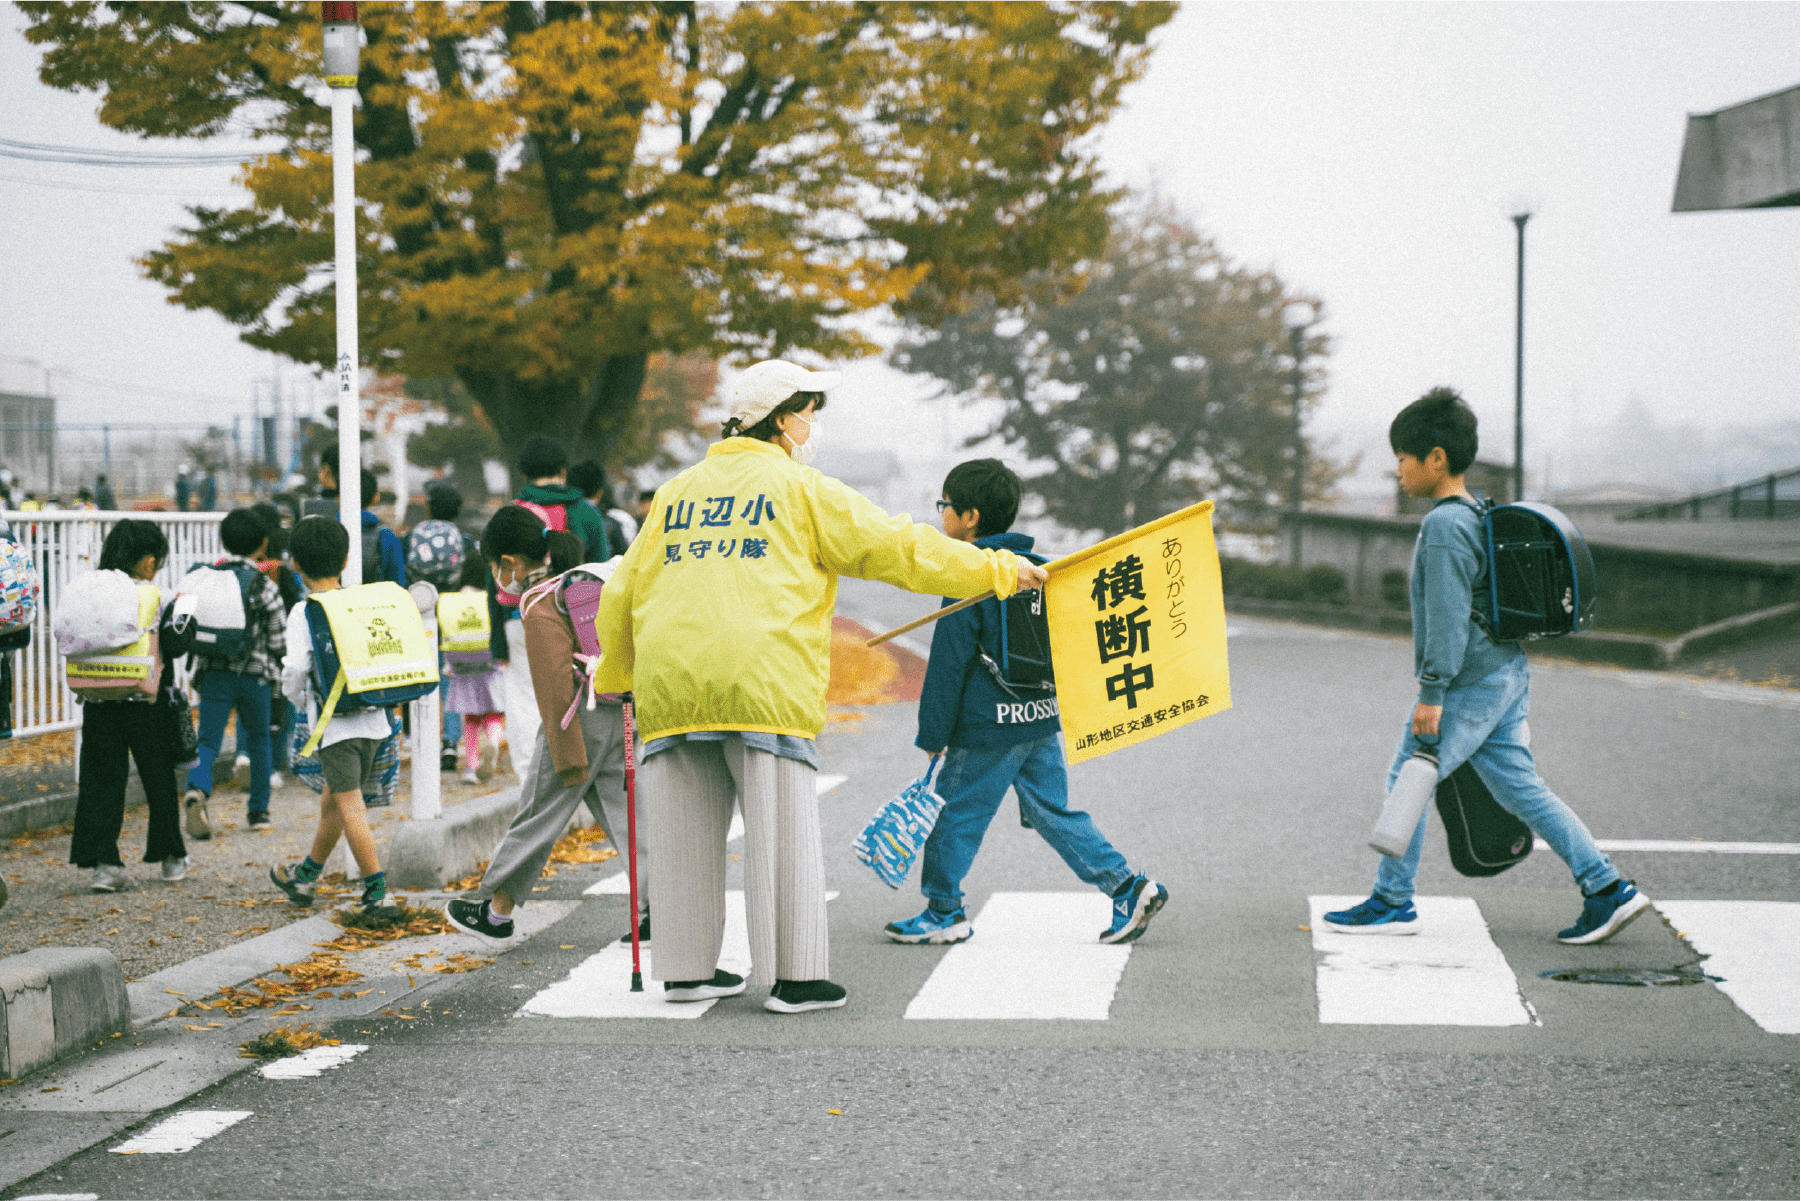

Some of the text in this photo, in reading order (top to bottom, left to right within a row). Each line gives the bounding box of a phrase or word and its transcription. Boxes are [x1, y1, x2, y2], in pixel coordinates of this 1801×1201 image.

[664, 494, 776, 533] 山辺小
[663, 538, 769, 565] 見守り隊
[1162, 537, 1188, 639] ありがとう
[1090, 554, 1155, 710] 横断中
[1075, 694, 1210, 751] 山形地区交通安全協会
